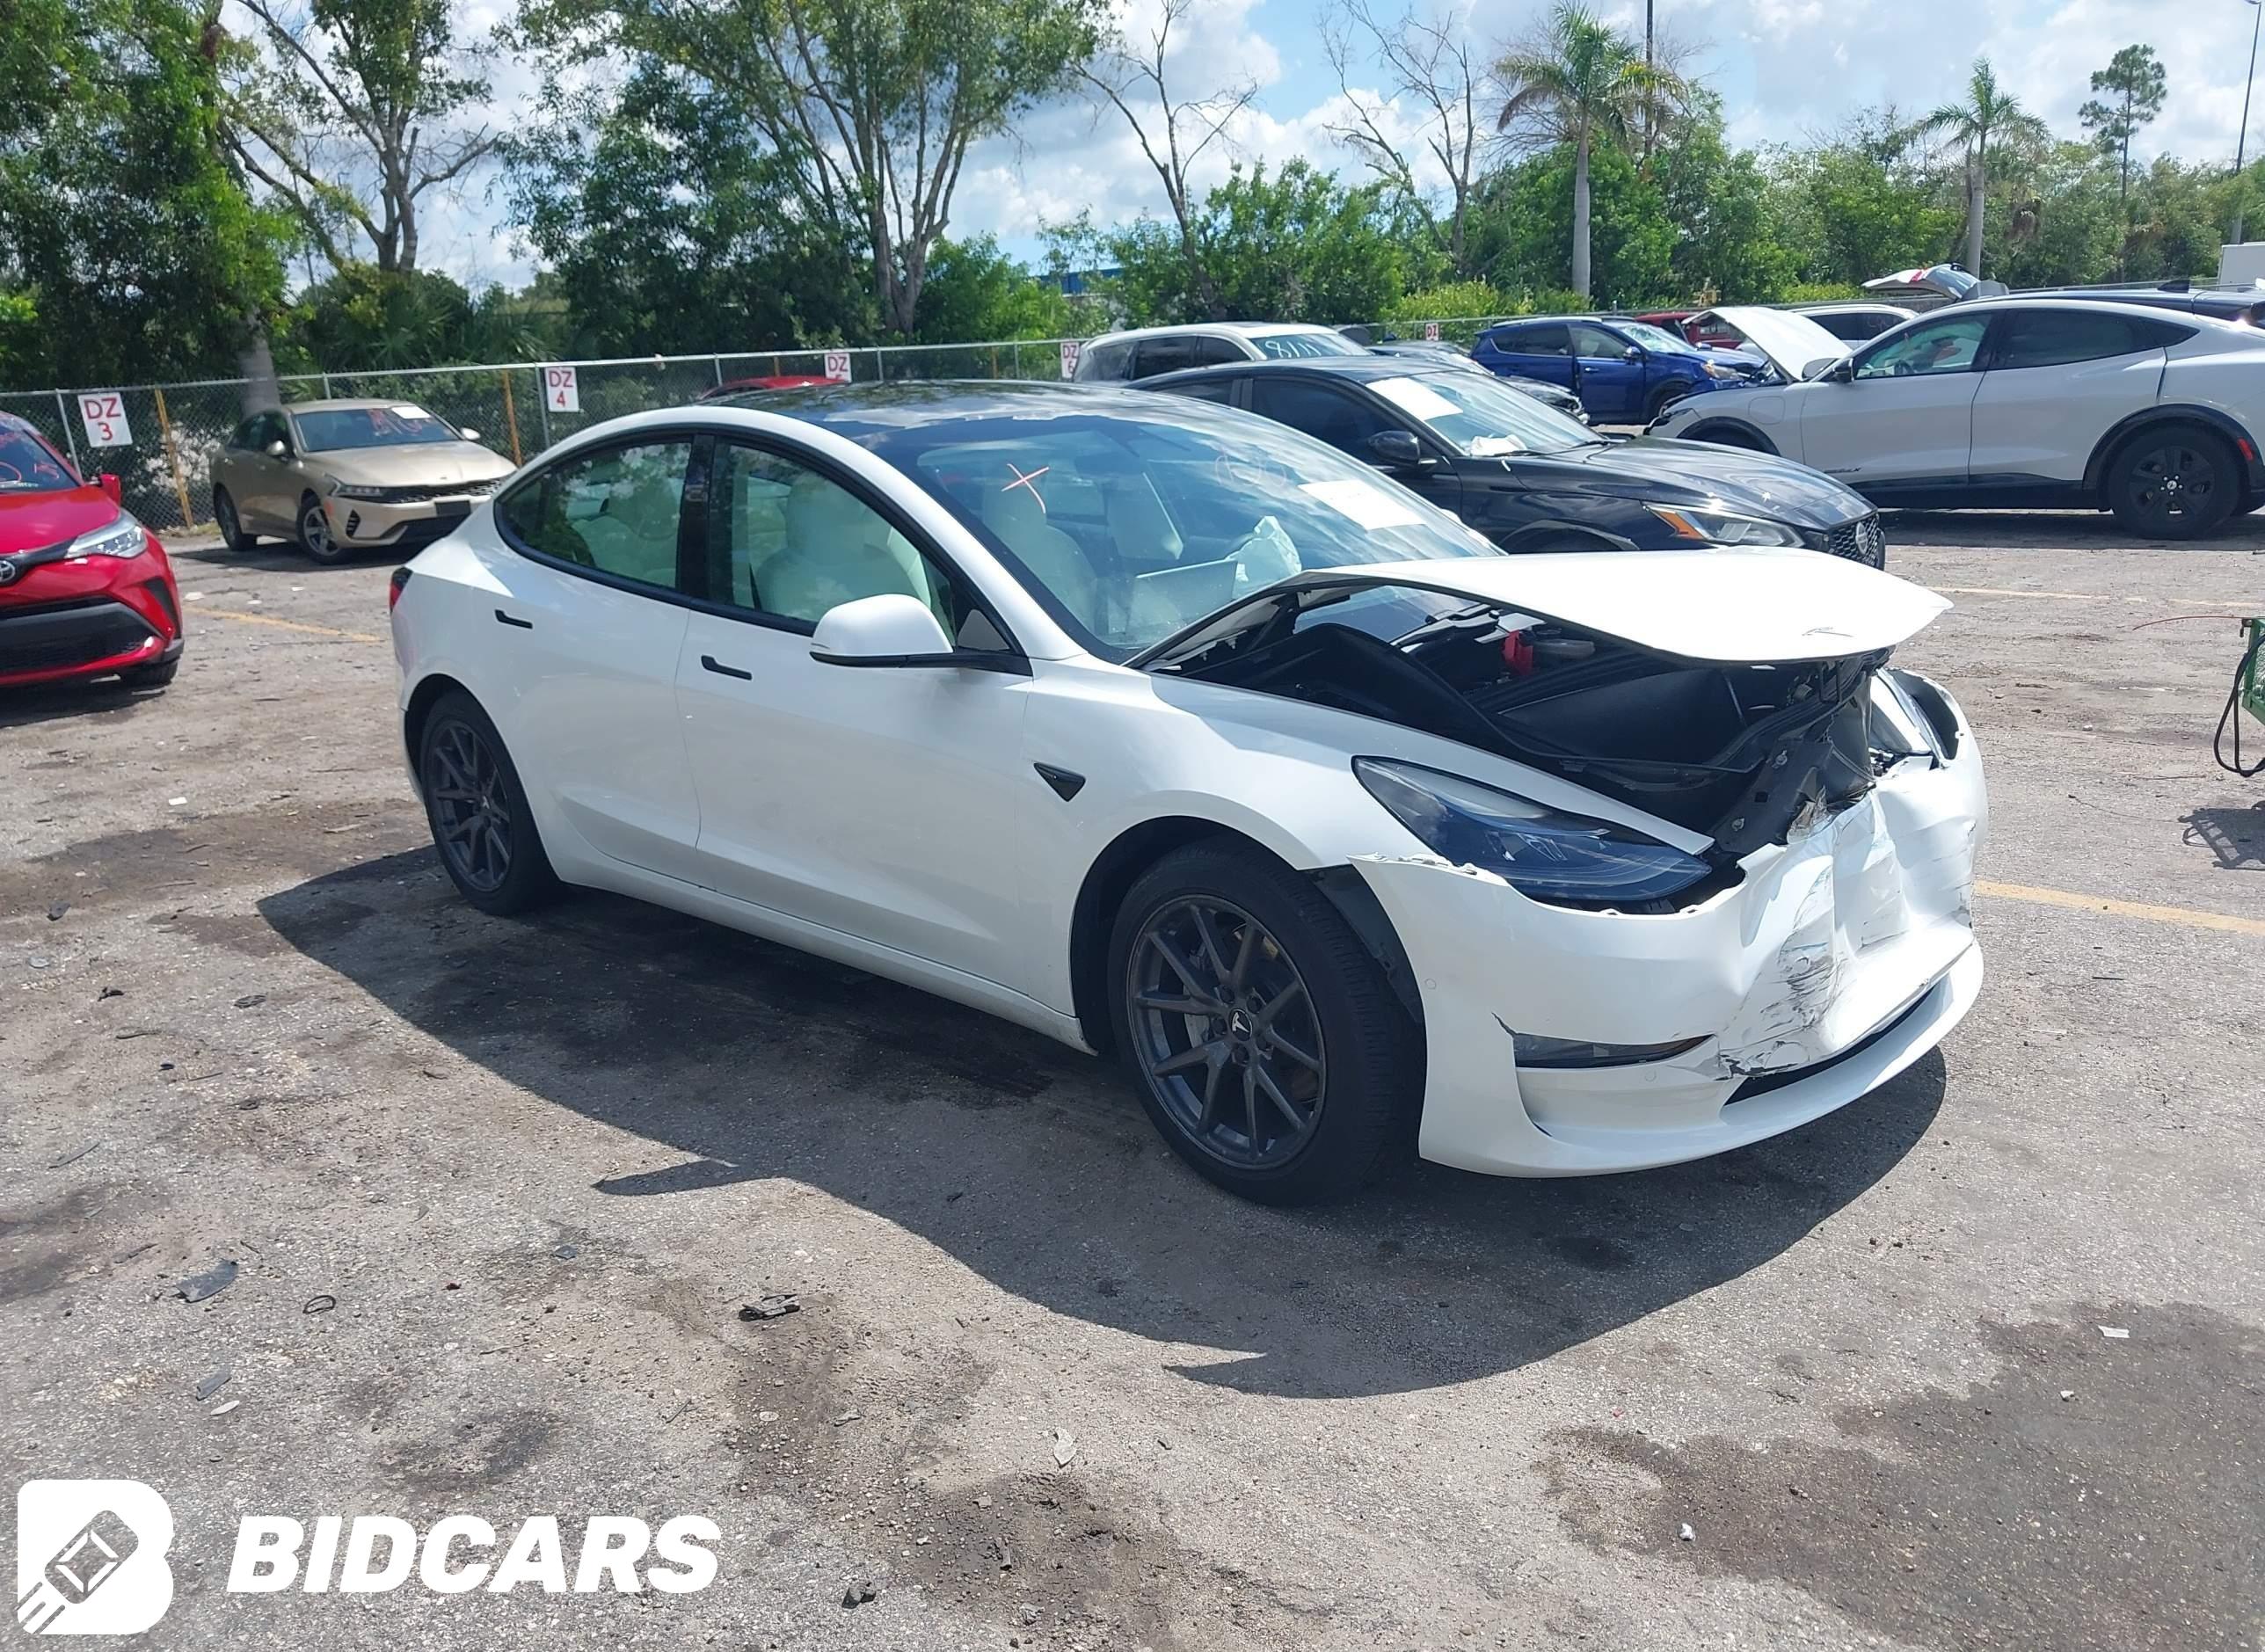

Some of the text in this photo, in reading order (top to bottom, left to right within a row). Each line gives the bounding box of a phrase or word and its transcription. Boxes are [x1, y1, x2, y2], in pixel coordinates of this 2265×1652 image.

[1063, 345, 1077, 359] DZ
[827, 356, 848, 372] DZ
[549, 370, 574, 388] DZ
[557, 390, 566, 407] 4
[84, 397, 121, 419] DZ
[98, 422, 113, 441] 3
